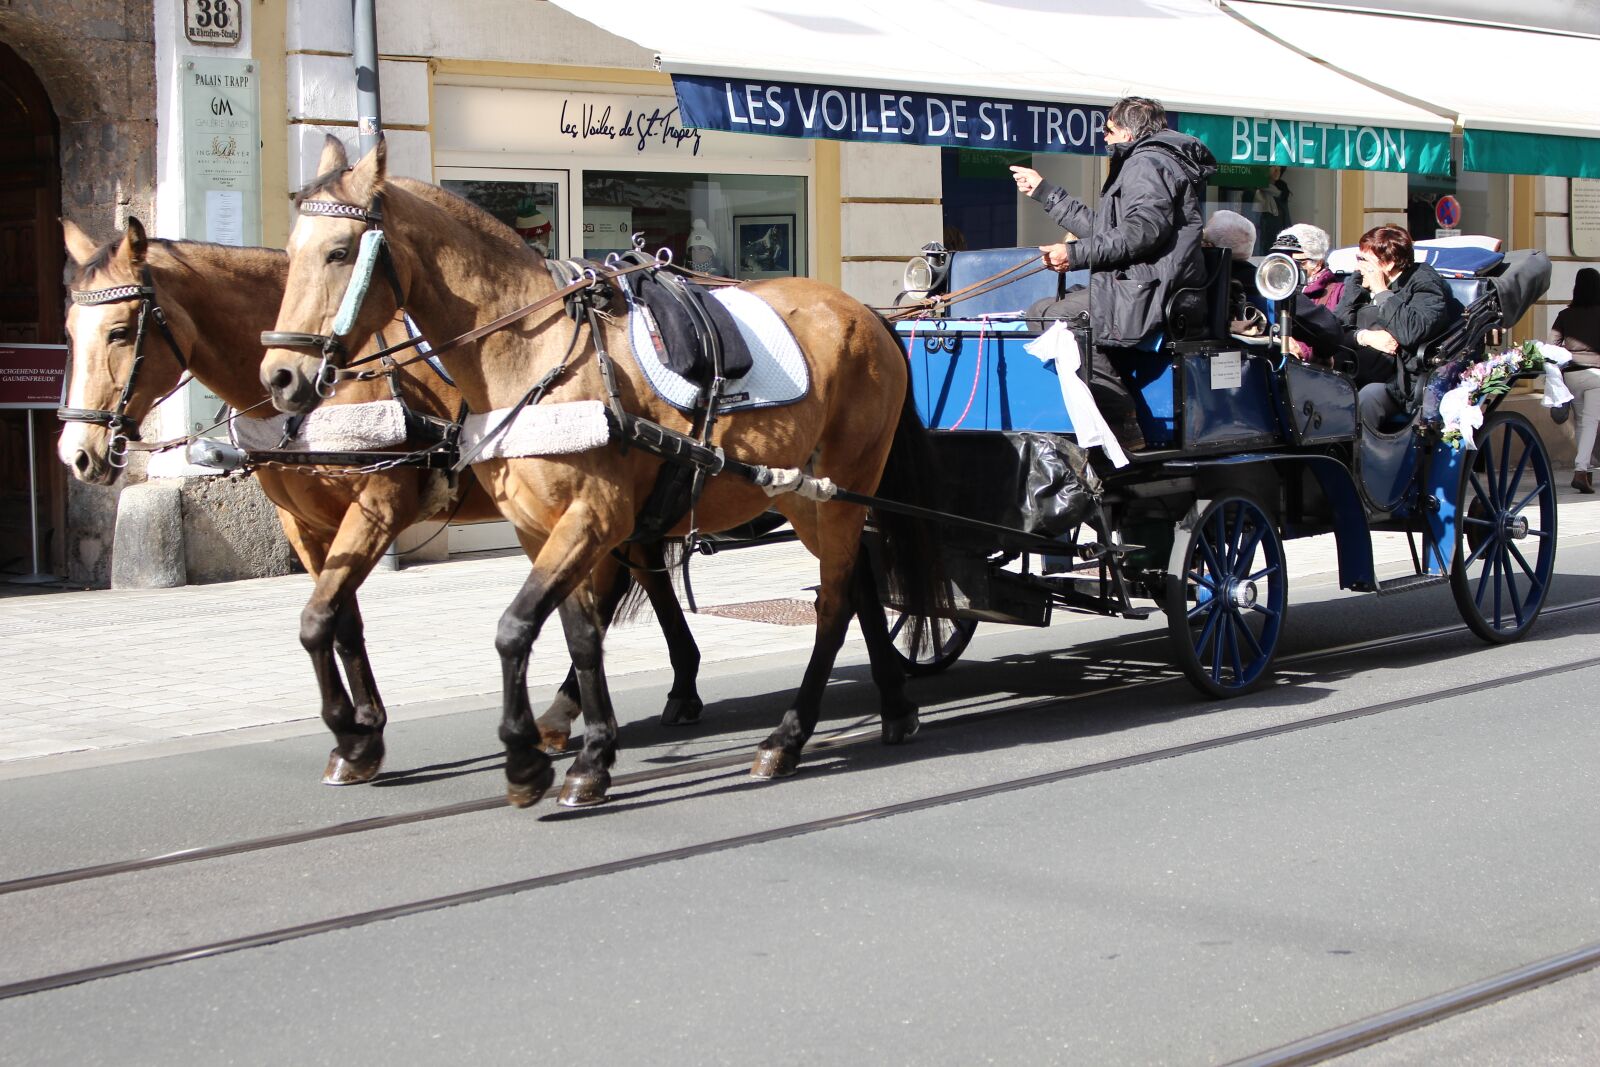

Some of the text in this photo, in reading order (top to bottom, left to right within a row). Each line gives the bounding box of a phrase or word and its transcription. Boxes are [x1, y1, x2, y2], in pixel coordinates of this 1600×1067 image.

[195, 0, 229, 28] 38
[195, 74, 249, 88] PALAIS TRAPP
[211, 96, 233, 117] GM
[560, 99, 578, 138] Les
[582, 103, 616, 139] Voiles
[619, 110, 634, 137] de
[725, 82, 785, 127] LES
[794, 87, 915, 135] VOILES
[926, 98, 969, 138] DE
[978, 102, 1017, 142] ST.
[1231, 116, 1406, 170] BENETTON
